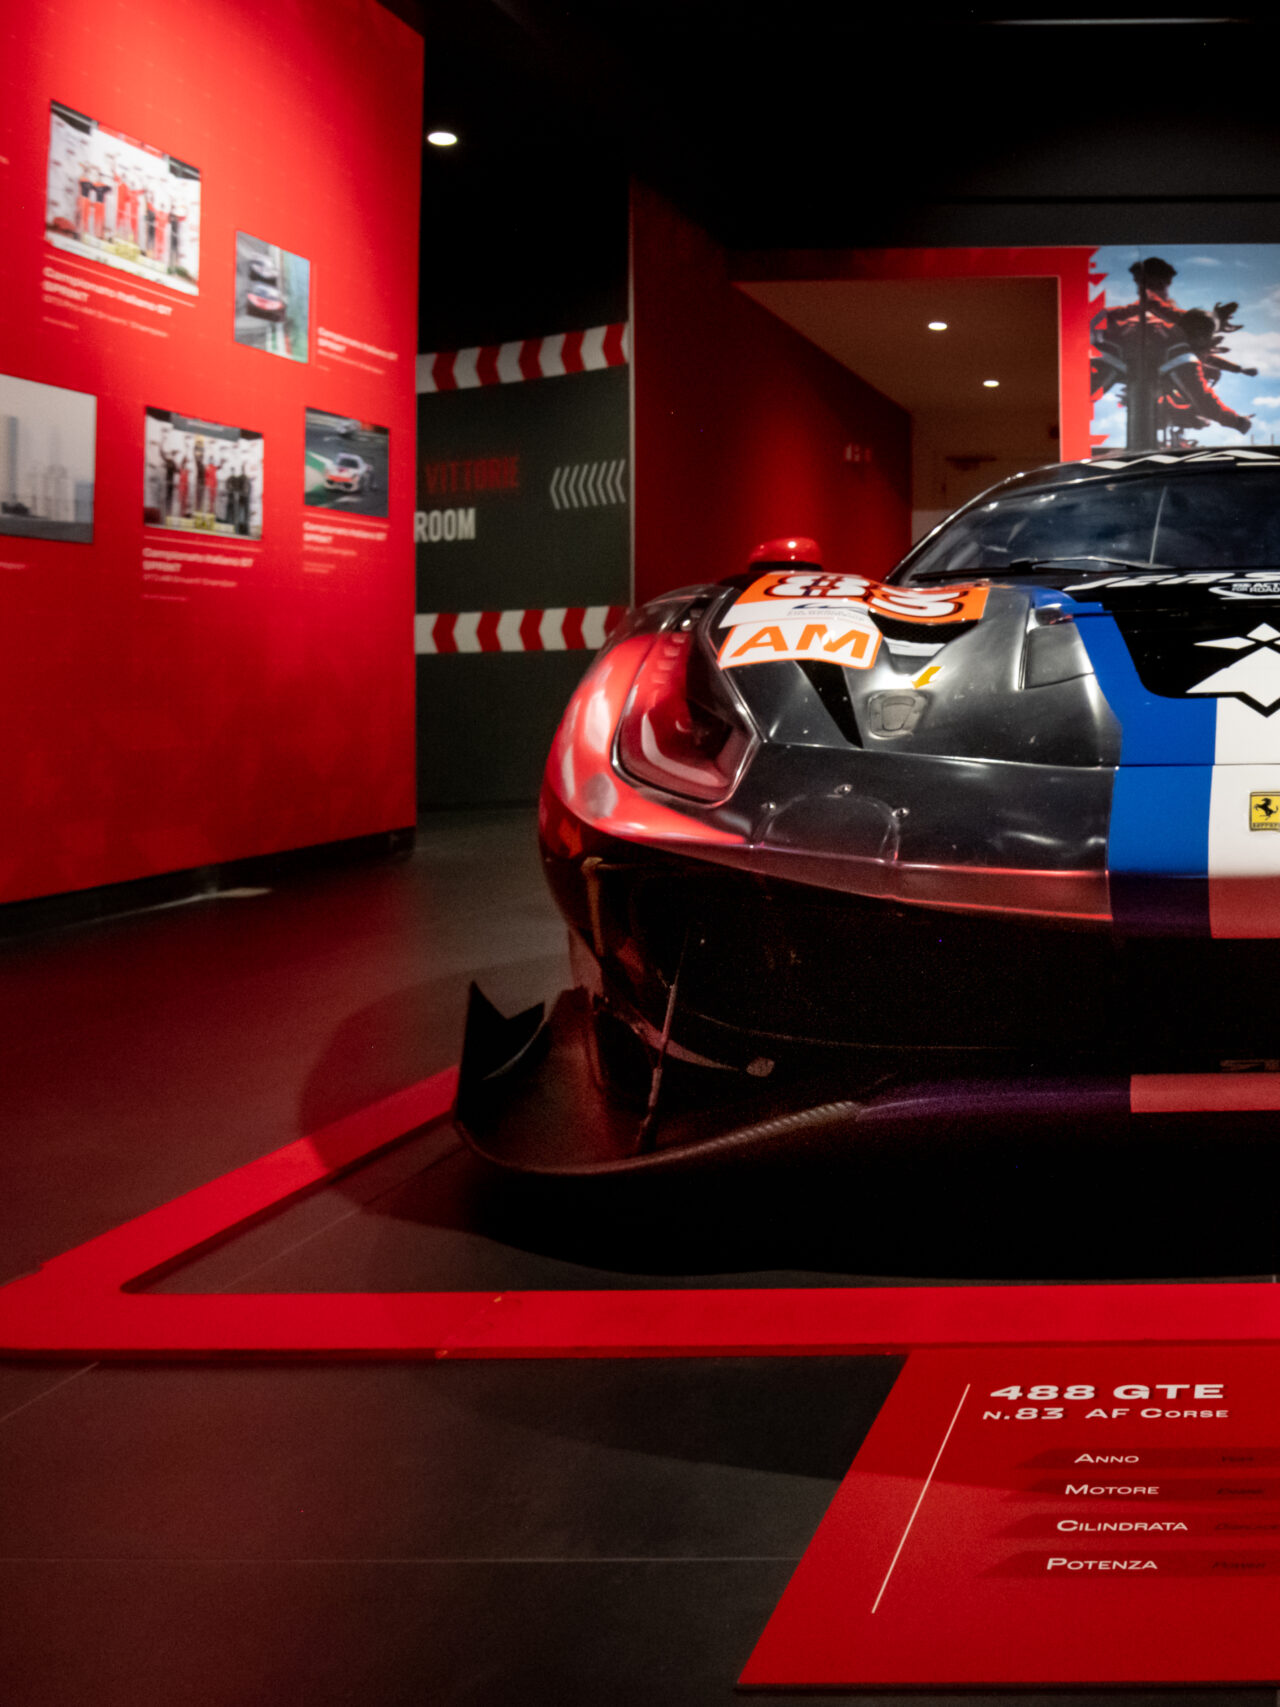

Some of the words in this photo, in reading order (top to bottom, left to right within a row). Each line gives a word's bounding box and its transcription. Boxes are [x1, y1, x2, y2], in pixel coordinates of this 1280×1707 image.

[414, 507, 476, 543] ROOM
[730, 624, 870, 659] AM
[990, 1384, 1096, 1400] 488
[1113, 1384, 1225, 1400] GTE
[982, 1407, 1065, 1420] N.83
[1085, 1408, 1130, 1419] AF
[1140, 1407, 1229, 1419] CORSE
[1074, 1453, 1140, 1464] ANNO
[1065, 1484, 1160, 1495] MOTORE
[1056, 1520, 1188, 1532] CILINDRATA
[1046, 1557, 1158, 1570] POTENZA
